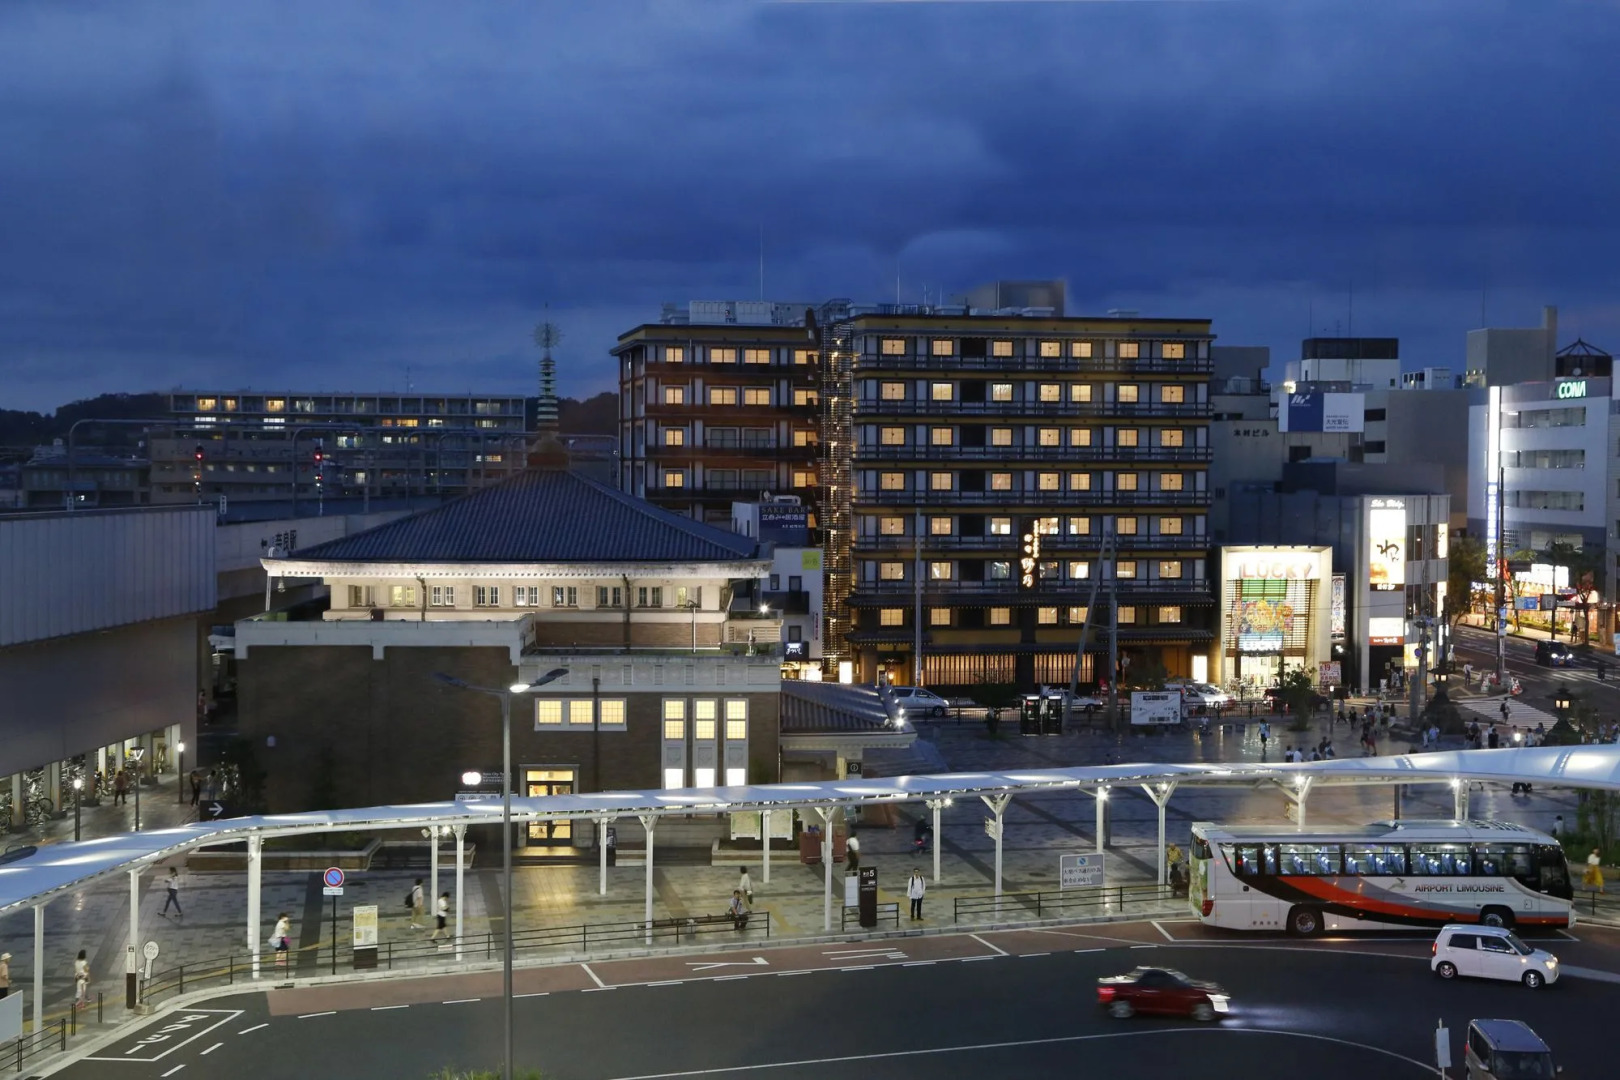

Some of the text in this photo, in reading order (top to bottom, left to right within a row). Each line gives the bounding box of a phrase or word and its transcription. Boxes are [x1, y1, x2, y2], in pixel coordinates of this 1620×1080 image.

[1241, 562, 1313, 579] LUCKY
[1415, 884, 1505, 893] AIRPORT LIMOUSINE
[124, 1014, 210, 1055] タクシー
